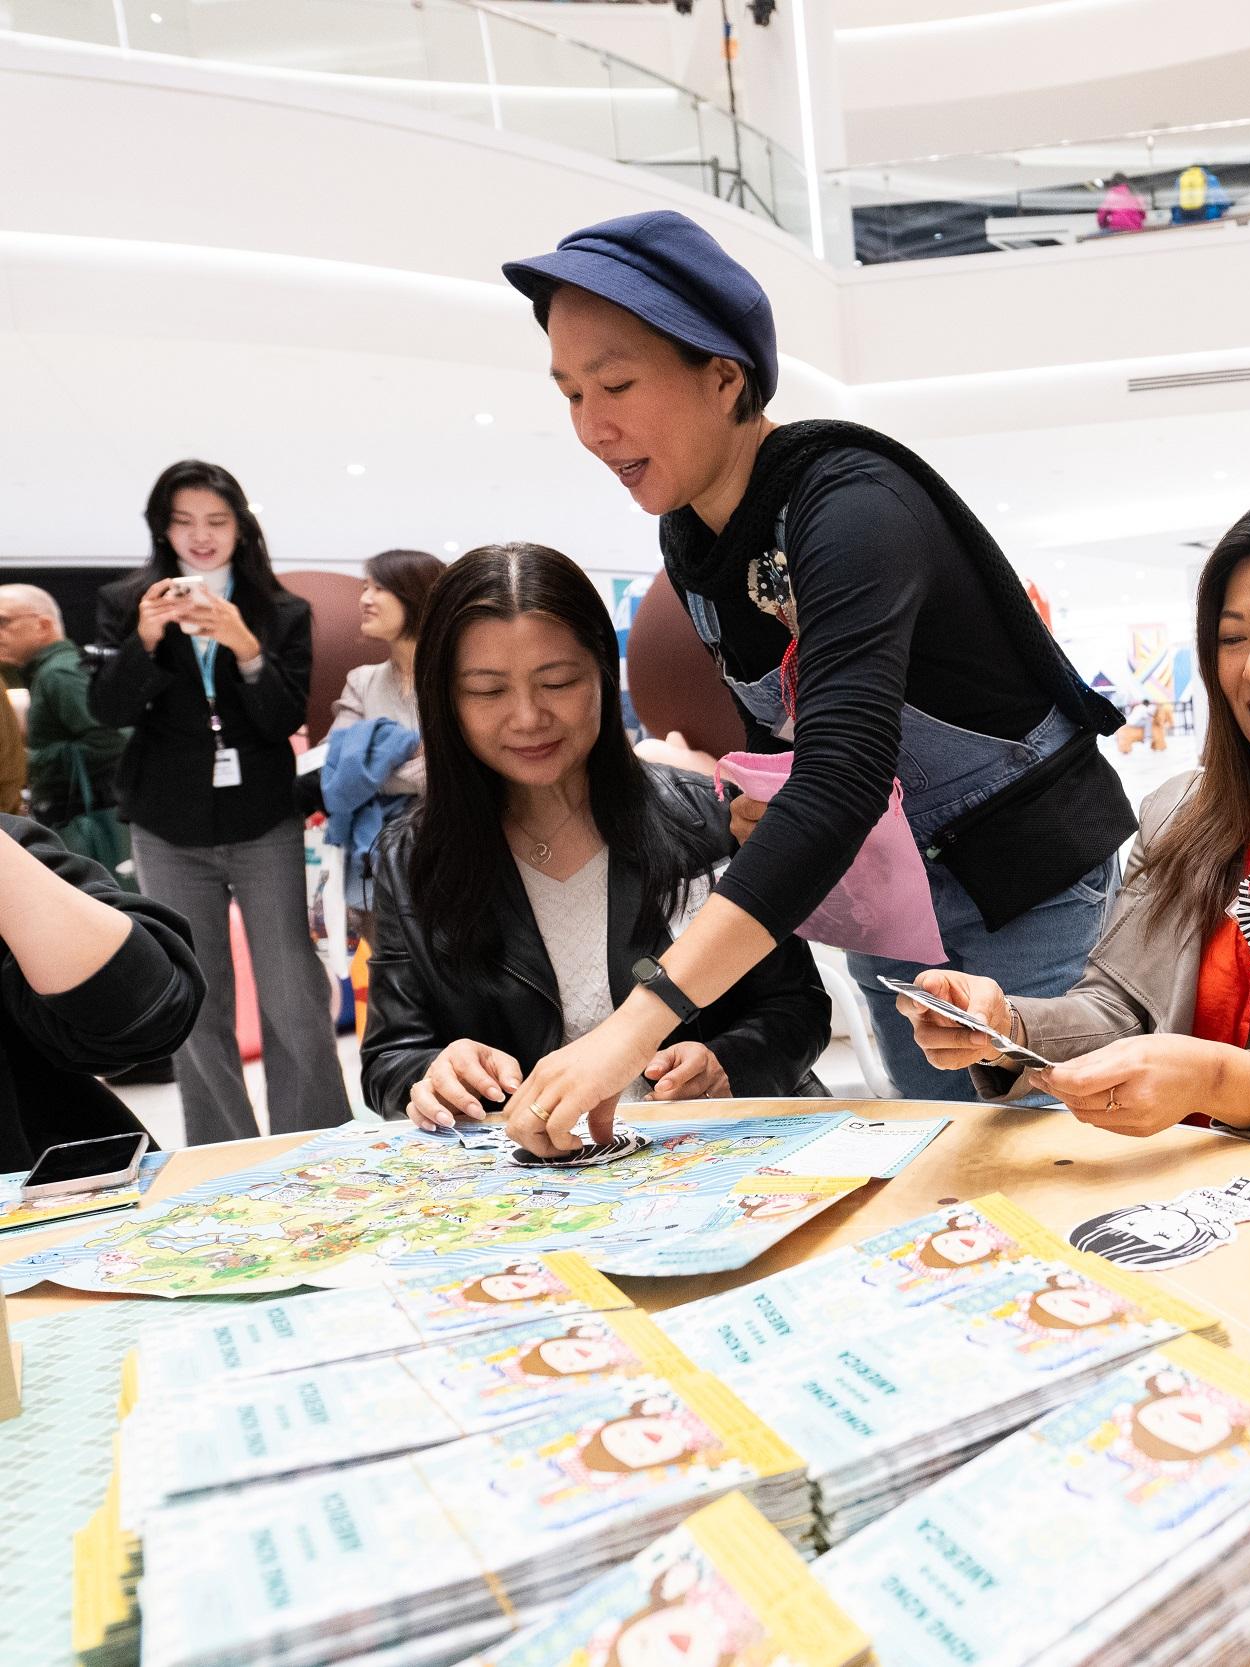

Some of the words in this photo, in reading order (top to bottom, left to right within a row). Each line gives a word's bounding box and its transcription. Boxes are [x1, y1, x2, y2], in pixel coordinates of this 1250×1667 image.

[753, 1293, 792, 1336] AMERICA
[718, 1323, 740, 1351] KONG
[838, 1351, 898, 1394] AMERICA
[803, 1380, 839, 1409] KONG
[837, 1409, 876, 1437] HONG
[917, 1518, 996, 1590] AMERICA
[881, 1575, 928, 1618] KONG
[927, 1618, 977, 1664] HONG
